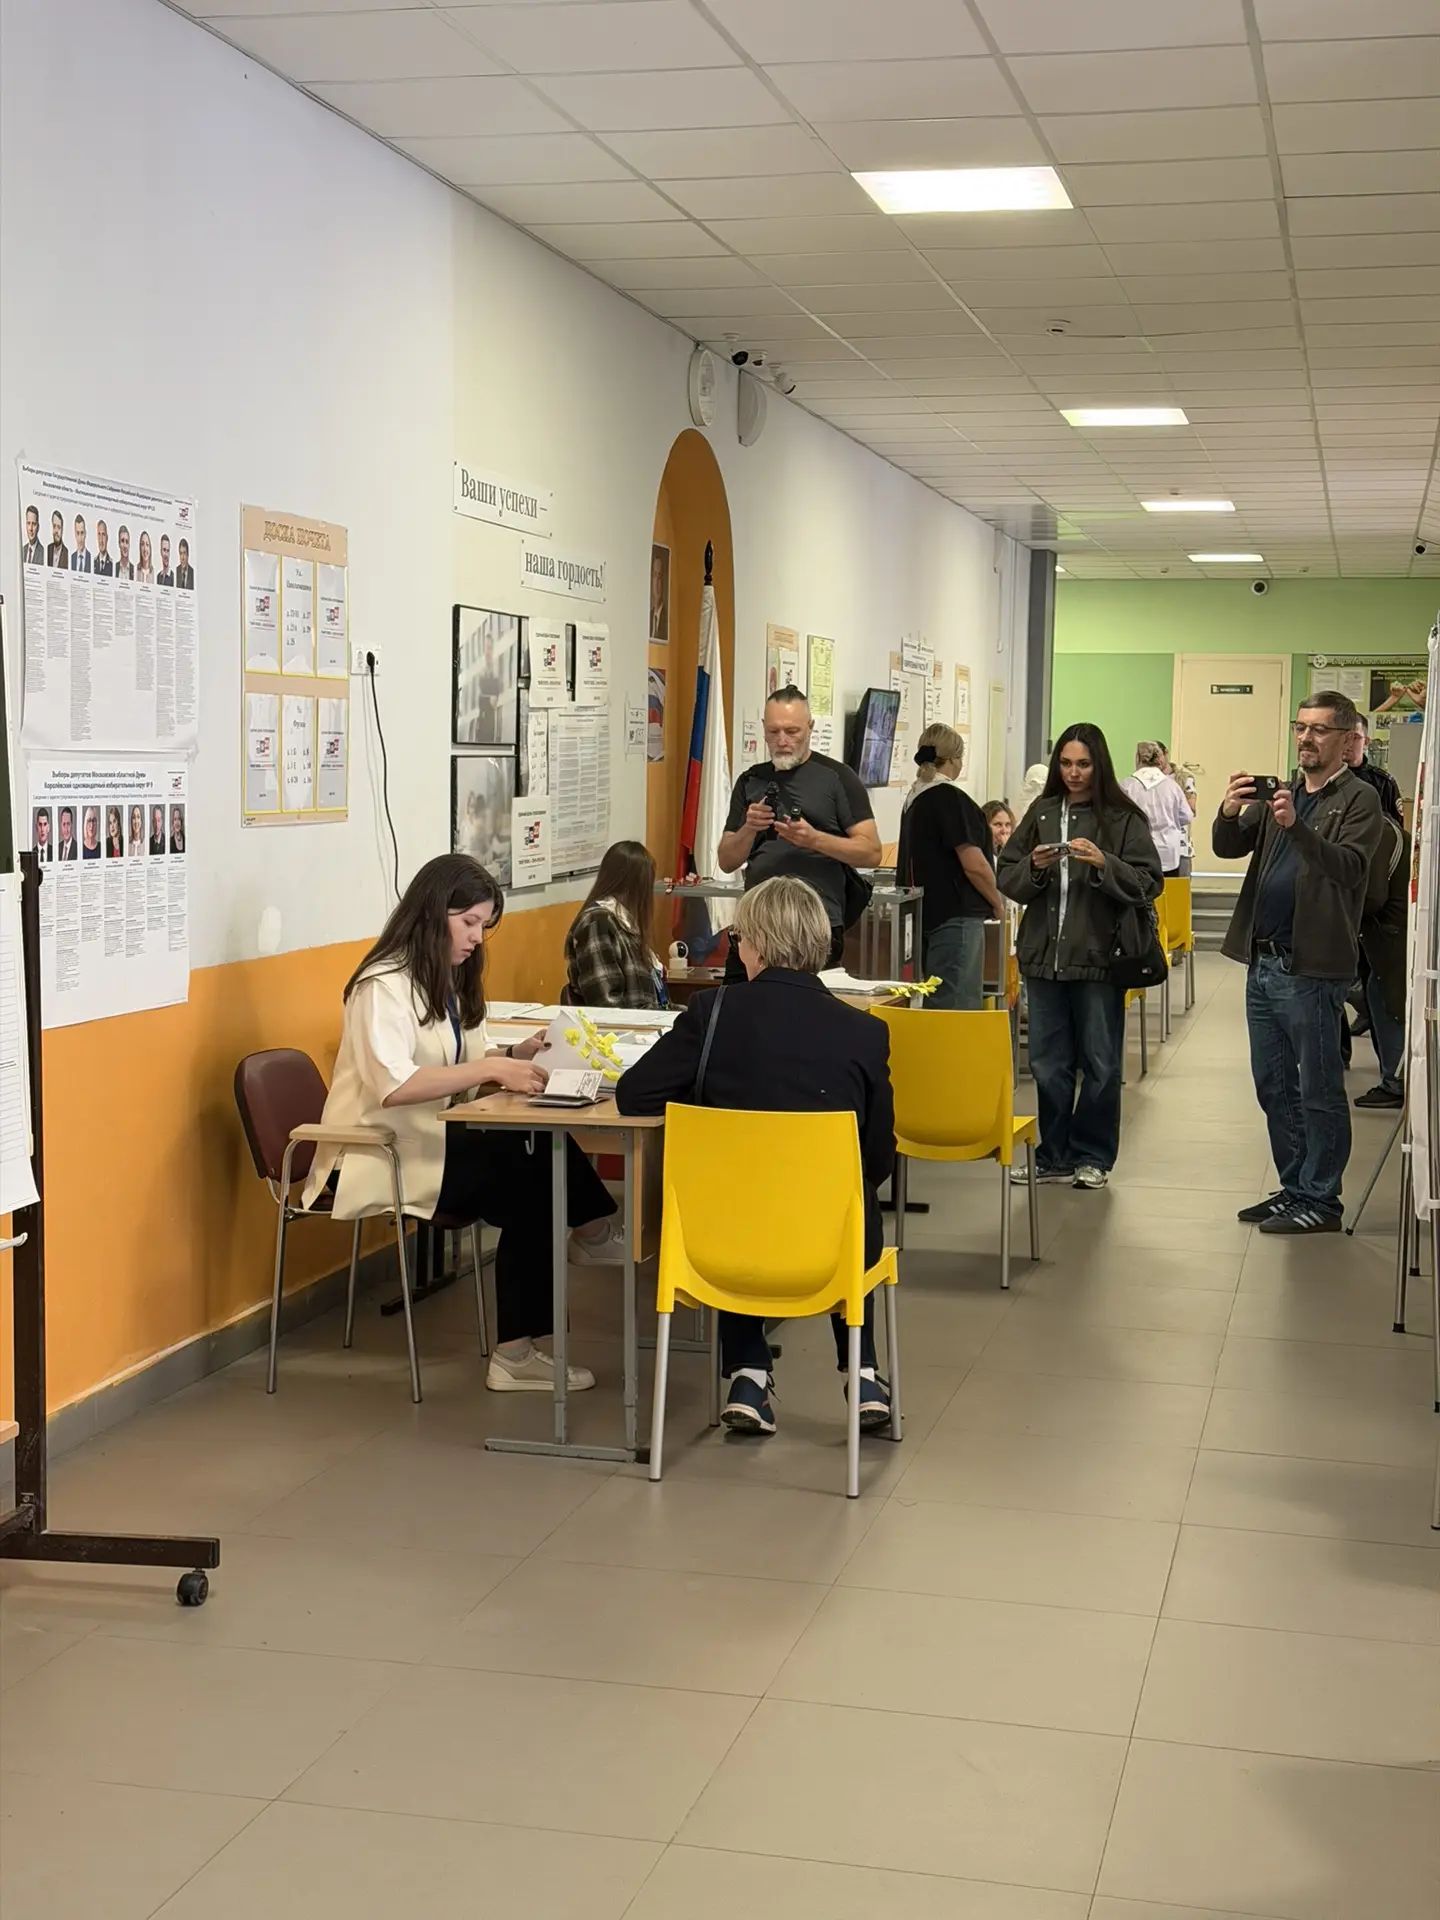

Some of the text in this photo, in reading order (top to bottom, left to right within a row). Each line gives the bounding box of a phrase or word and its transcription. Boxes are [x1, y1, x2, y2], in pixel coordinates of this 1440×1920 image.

[461, 468, 497, 507] Ваши
[499, 487, 538, 519] успехи
[525, 552, 604, 590] наша гордость!
